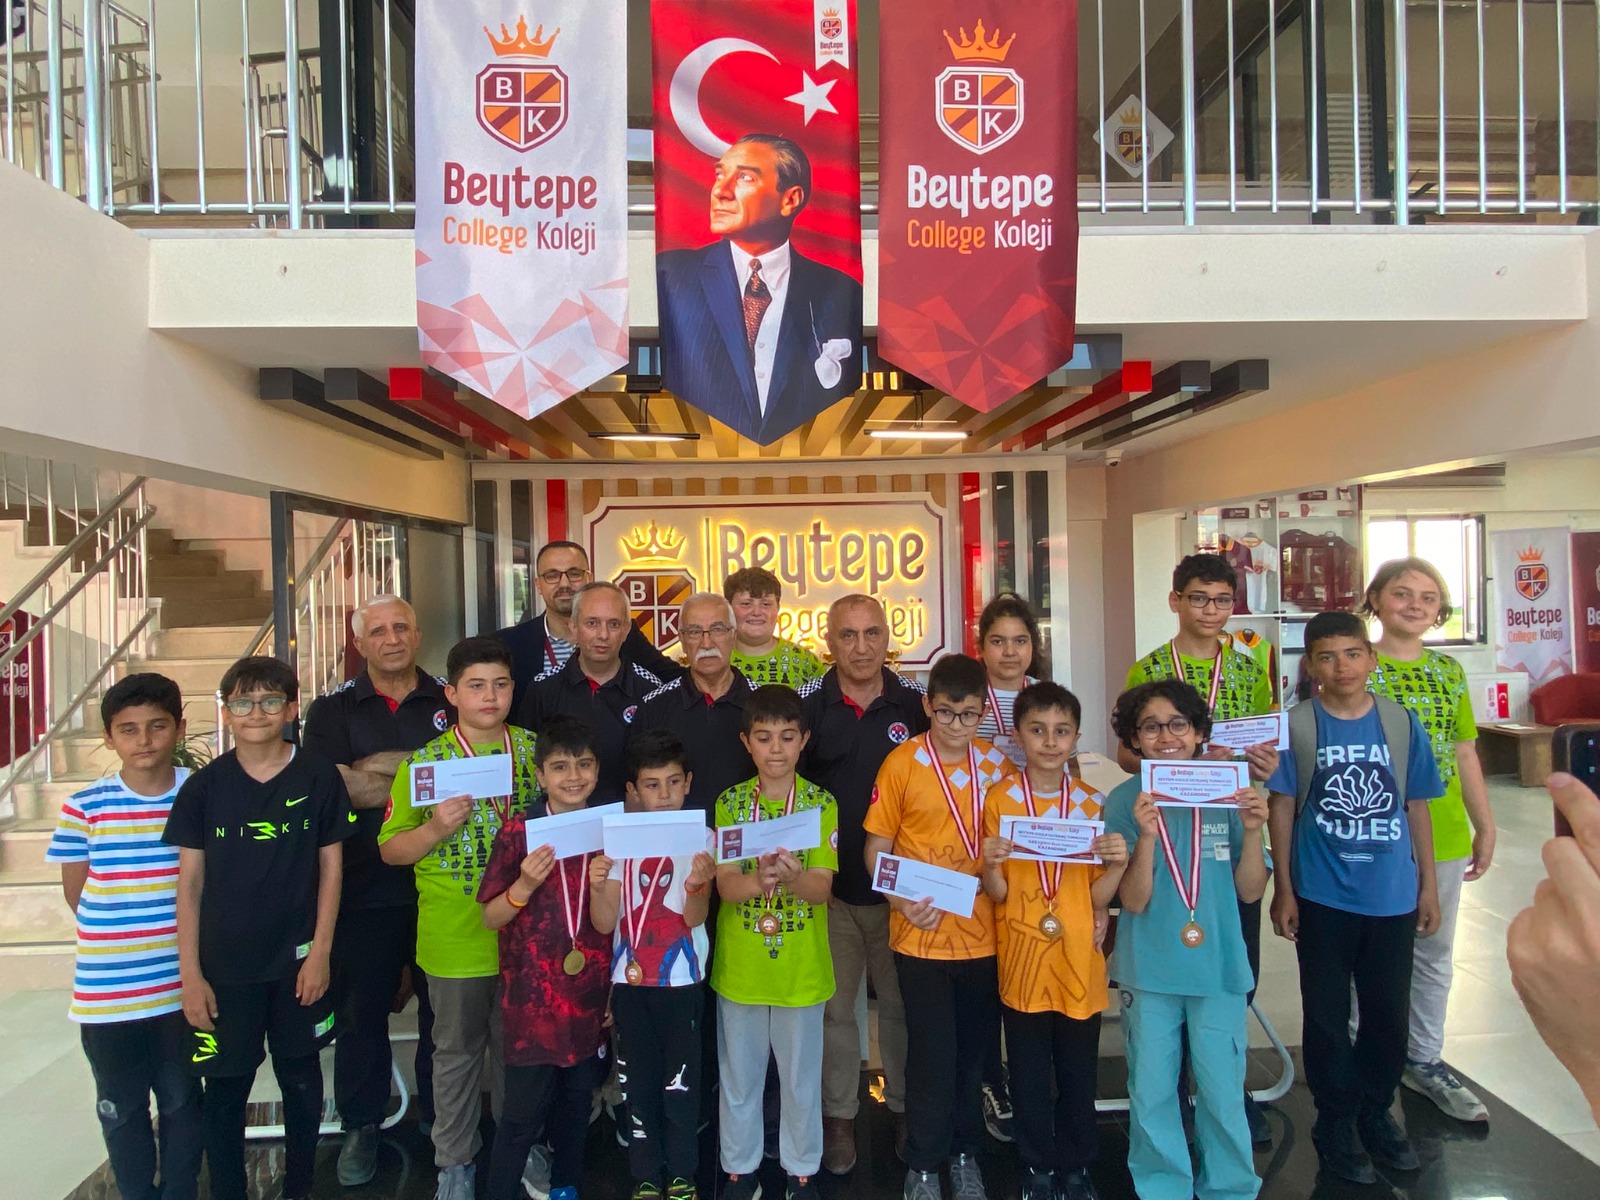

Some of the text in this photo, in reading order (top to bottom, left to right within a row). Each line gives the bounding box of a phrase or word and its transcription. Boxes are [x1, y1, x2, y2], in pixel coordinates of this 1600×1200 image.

[496, 77, 513, 98] B
[954, 80, 971, 101] B
[527, 110, 546, 132] K
[985, 112, 1003, 134] K
[444, 162, 597, 218] Beytepe
[908, 165, 1053, 218] Beytepe
[443, 216, 596, 256] College Koleji
[907, 218, 1052, 254] College Koleji
[719, 521, 924, 597] Beytepe
[1522, 570, 1529, 580] B
[630, 581, 646, 603] B
[1534, 582, 1541, 592] K
[661, 612, 679, 636] K
[1507, 607, 1562, 628] Beytepe
[1508, 627, 1563, 644] College Koleji
[3, 683, 29, 698] Kleji
